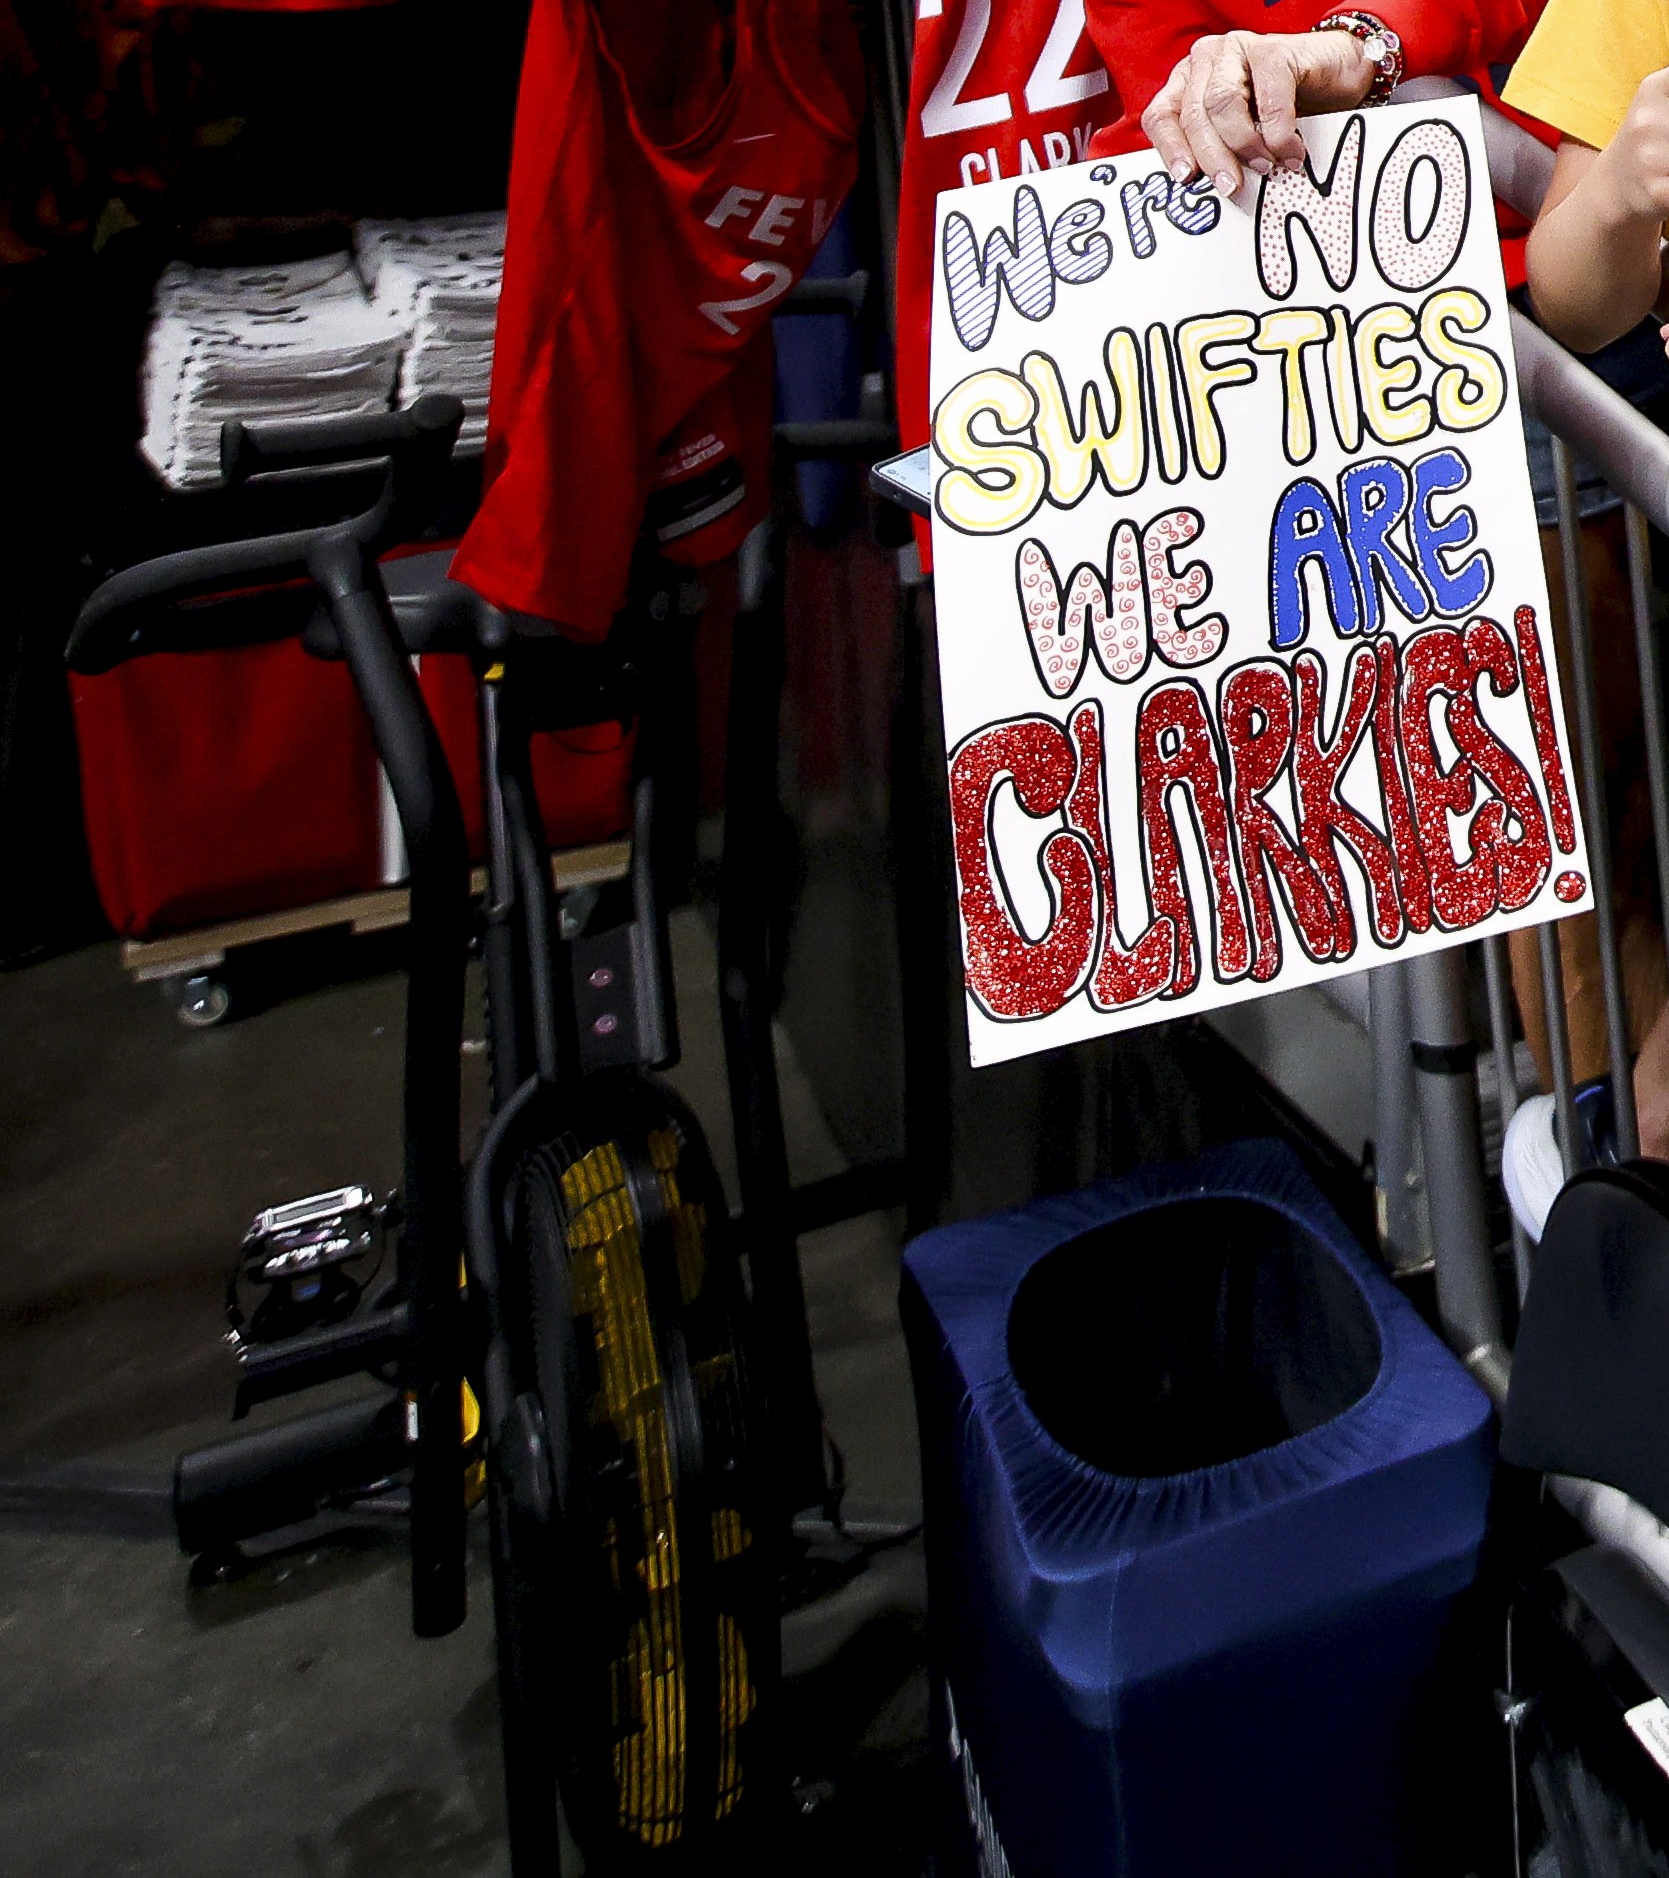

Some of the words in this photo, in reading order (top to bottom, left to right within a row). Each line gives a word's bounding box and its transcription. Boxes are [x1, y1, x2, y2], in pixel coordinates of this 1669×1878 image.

[942, 165, 1222, 352] We're
[1256, 114, 1472, 300] NO
[930, 288, 1507, 536] SWIFTIES
[1014, 506, 1230, 699] WE
[1268, 447, 1495, 653] ARE
[947, 604, 1589, 1024] CLARKIES!
